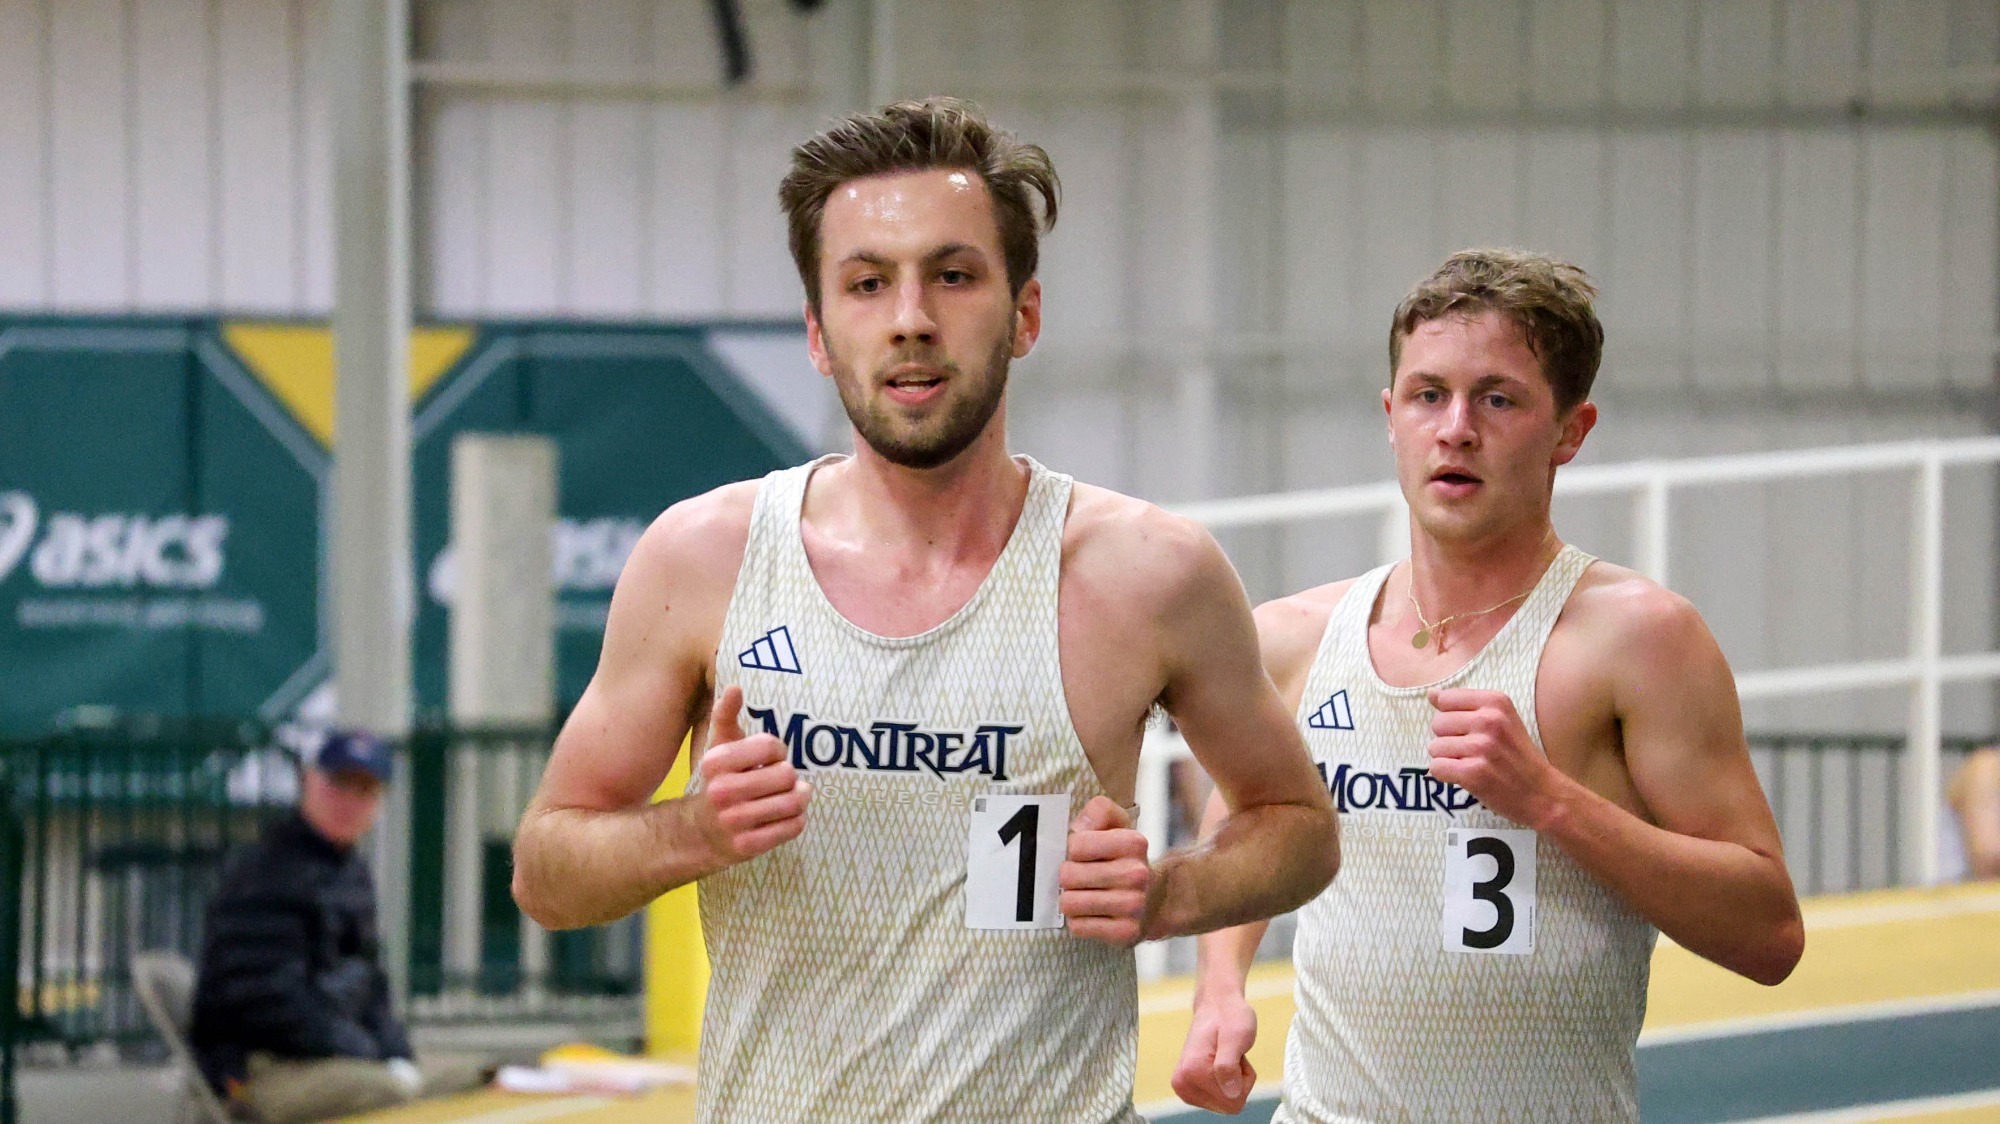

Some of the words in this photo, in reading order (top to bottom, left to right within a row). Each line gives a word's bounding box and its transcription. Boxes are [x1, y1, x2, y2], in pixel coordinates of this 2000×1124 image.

[819, 784, 964, 806] OLLEGE
[997, 804, 1040, 922] 1
[1462, 836, 1515, 949] 3
